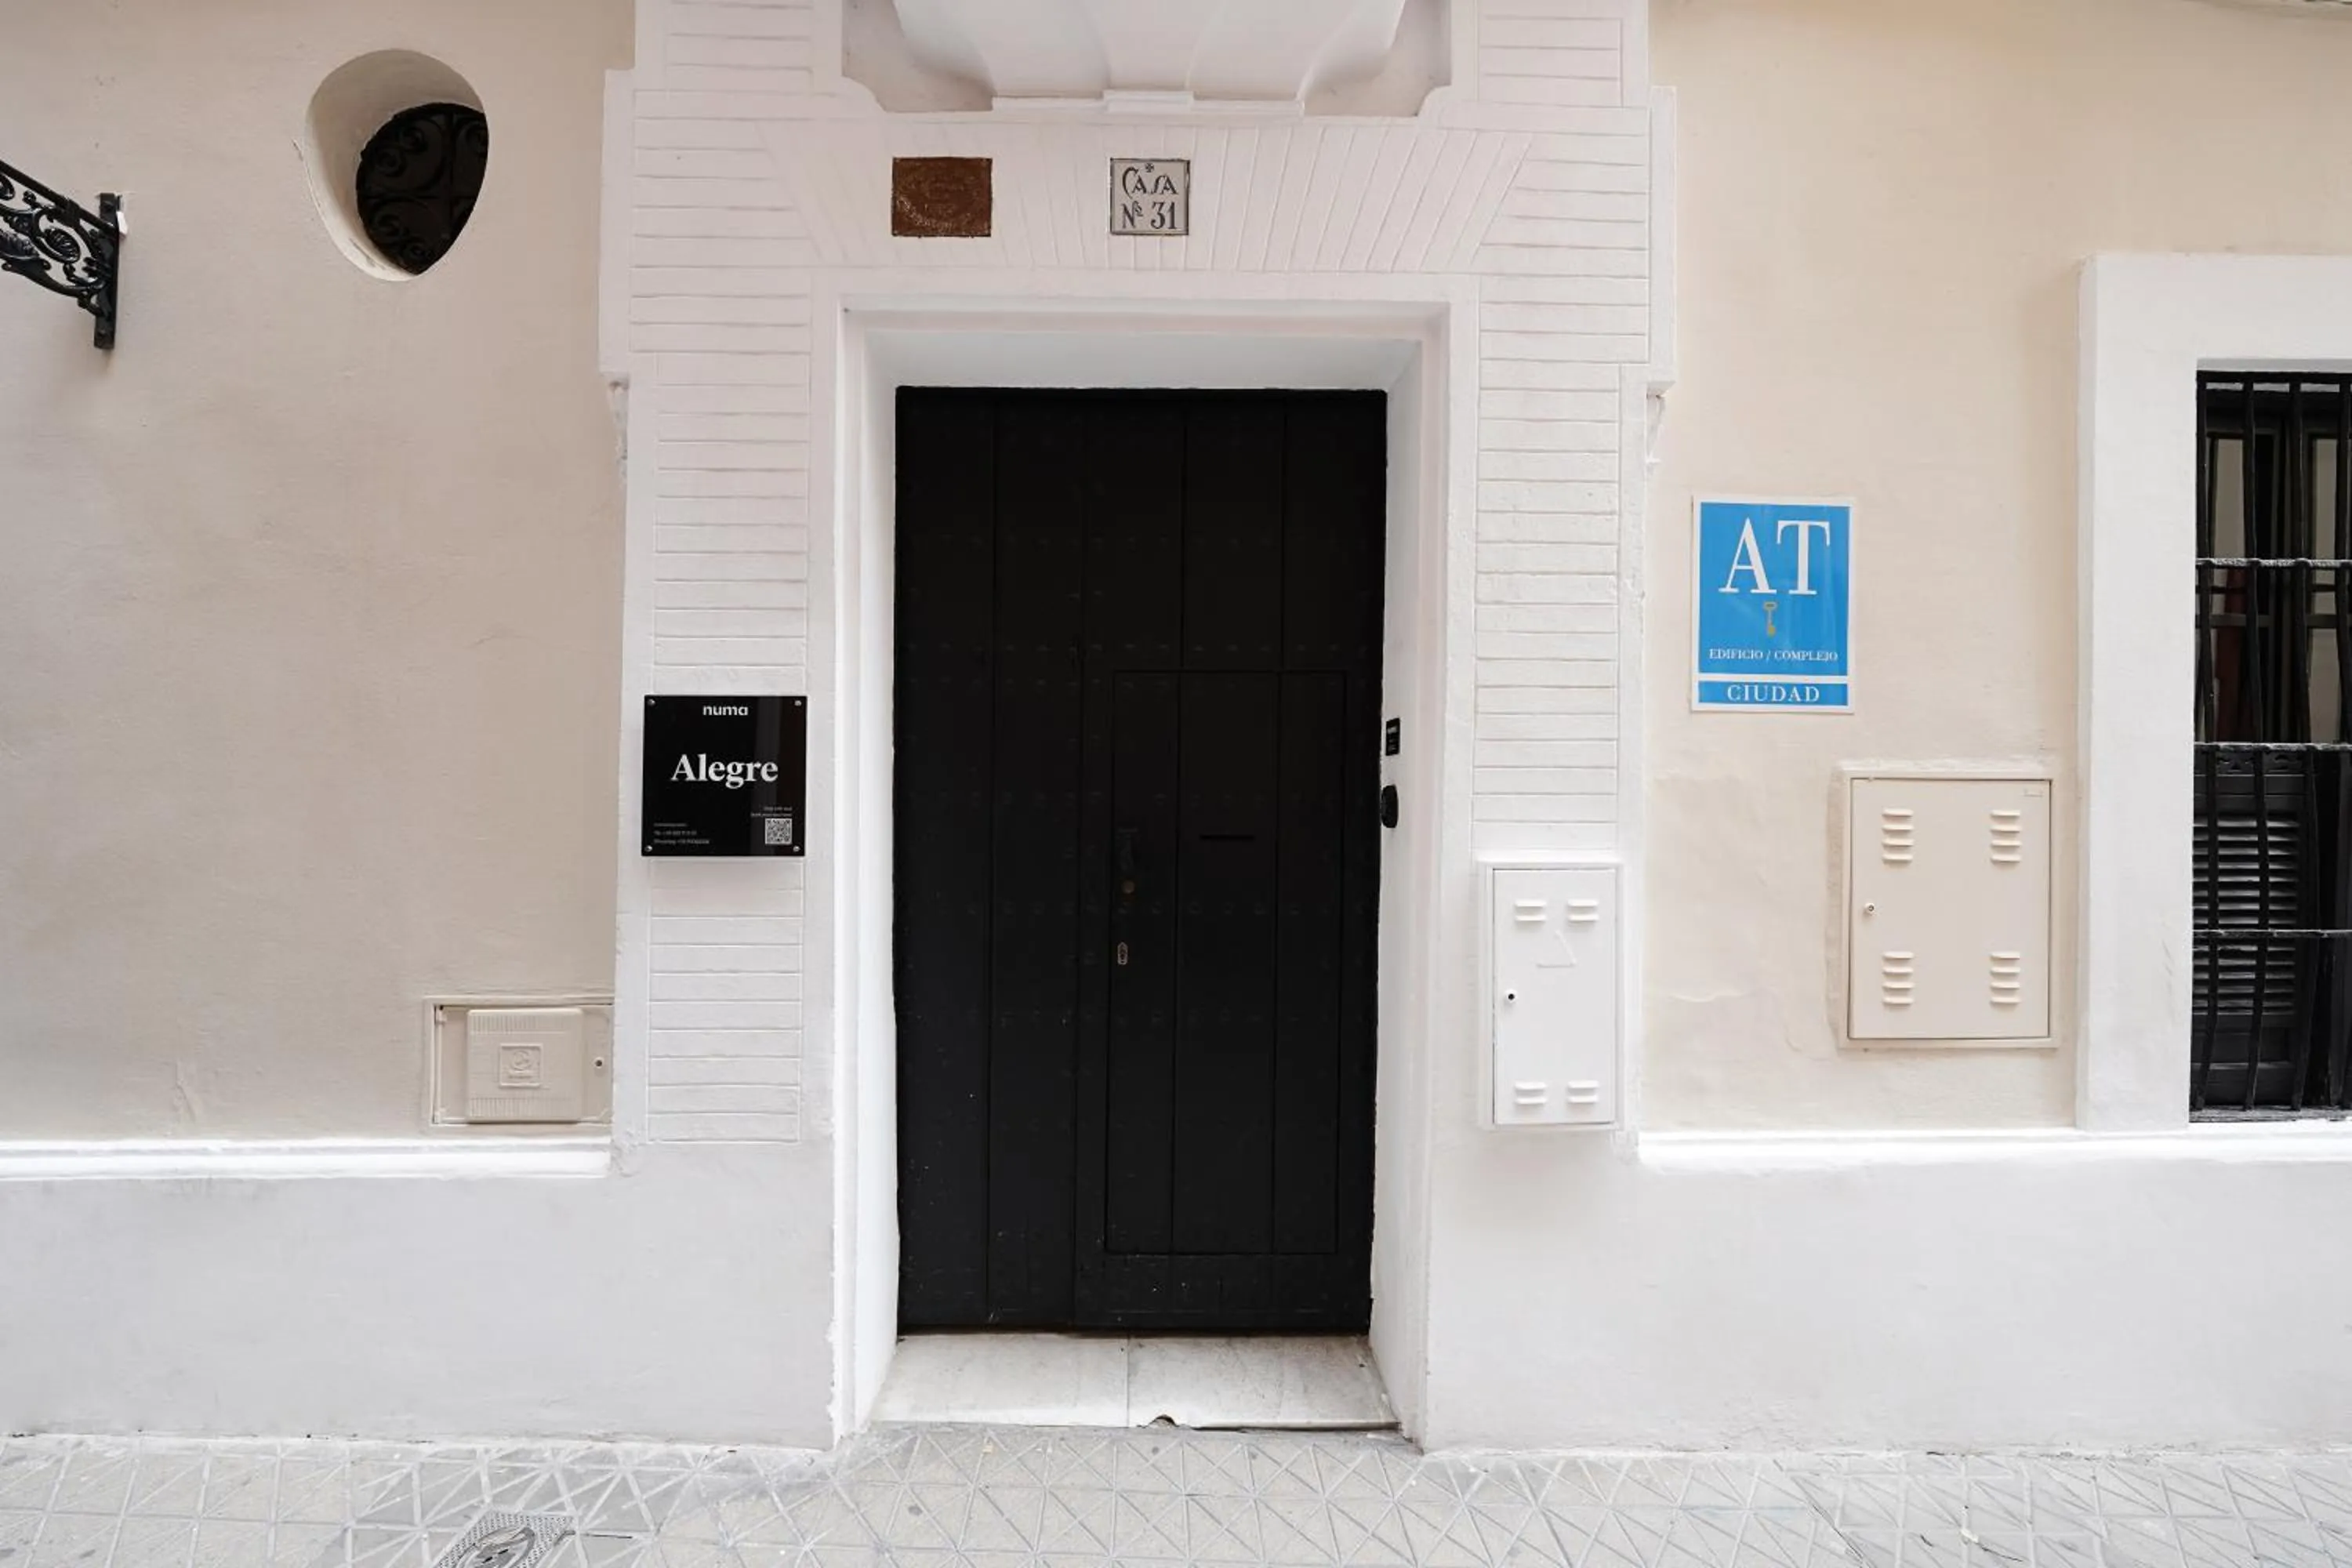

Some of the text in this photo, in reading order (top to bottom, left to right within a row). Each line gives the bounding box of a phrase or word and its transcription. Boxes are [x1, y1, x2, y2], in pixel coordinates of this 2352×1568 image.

[1150, 201, 1178, 230] 31
[1719, 517, 1831, 595] AT
[1709, 648, 1763, 660] EDIFICIO
[1774, 649, 1838, 662] COMPLEJO
[1727, 684, 1820, 702] CIUDAD
[702, 706, 749, 716] numa
[671, 753, 779, 789] Alegre
